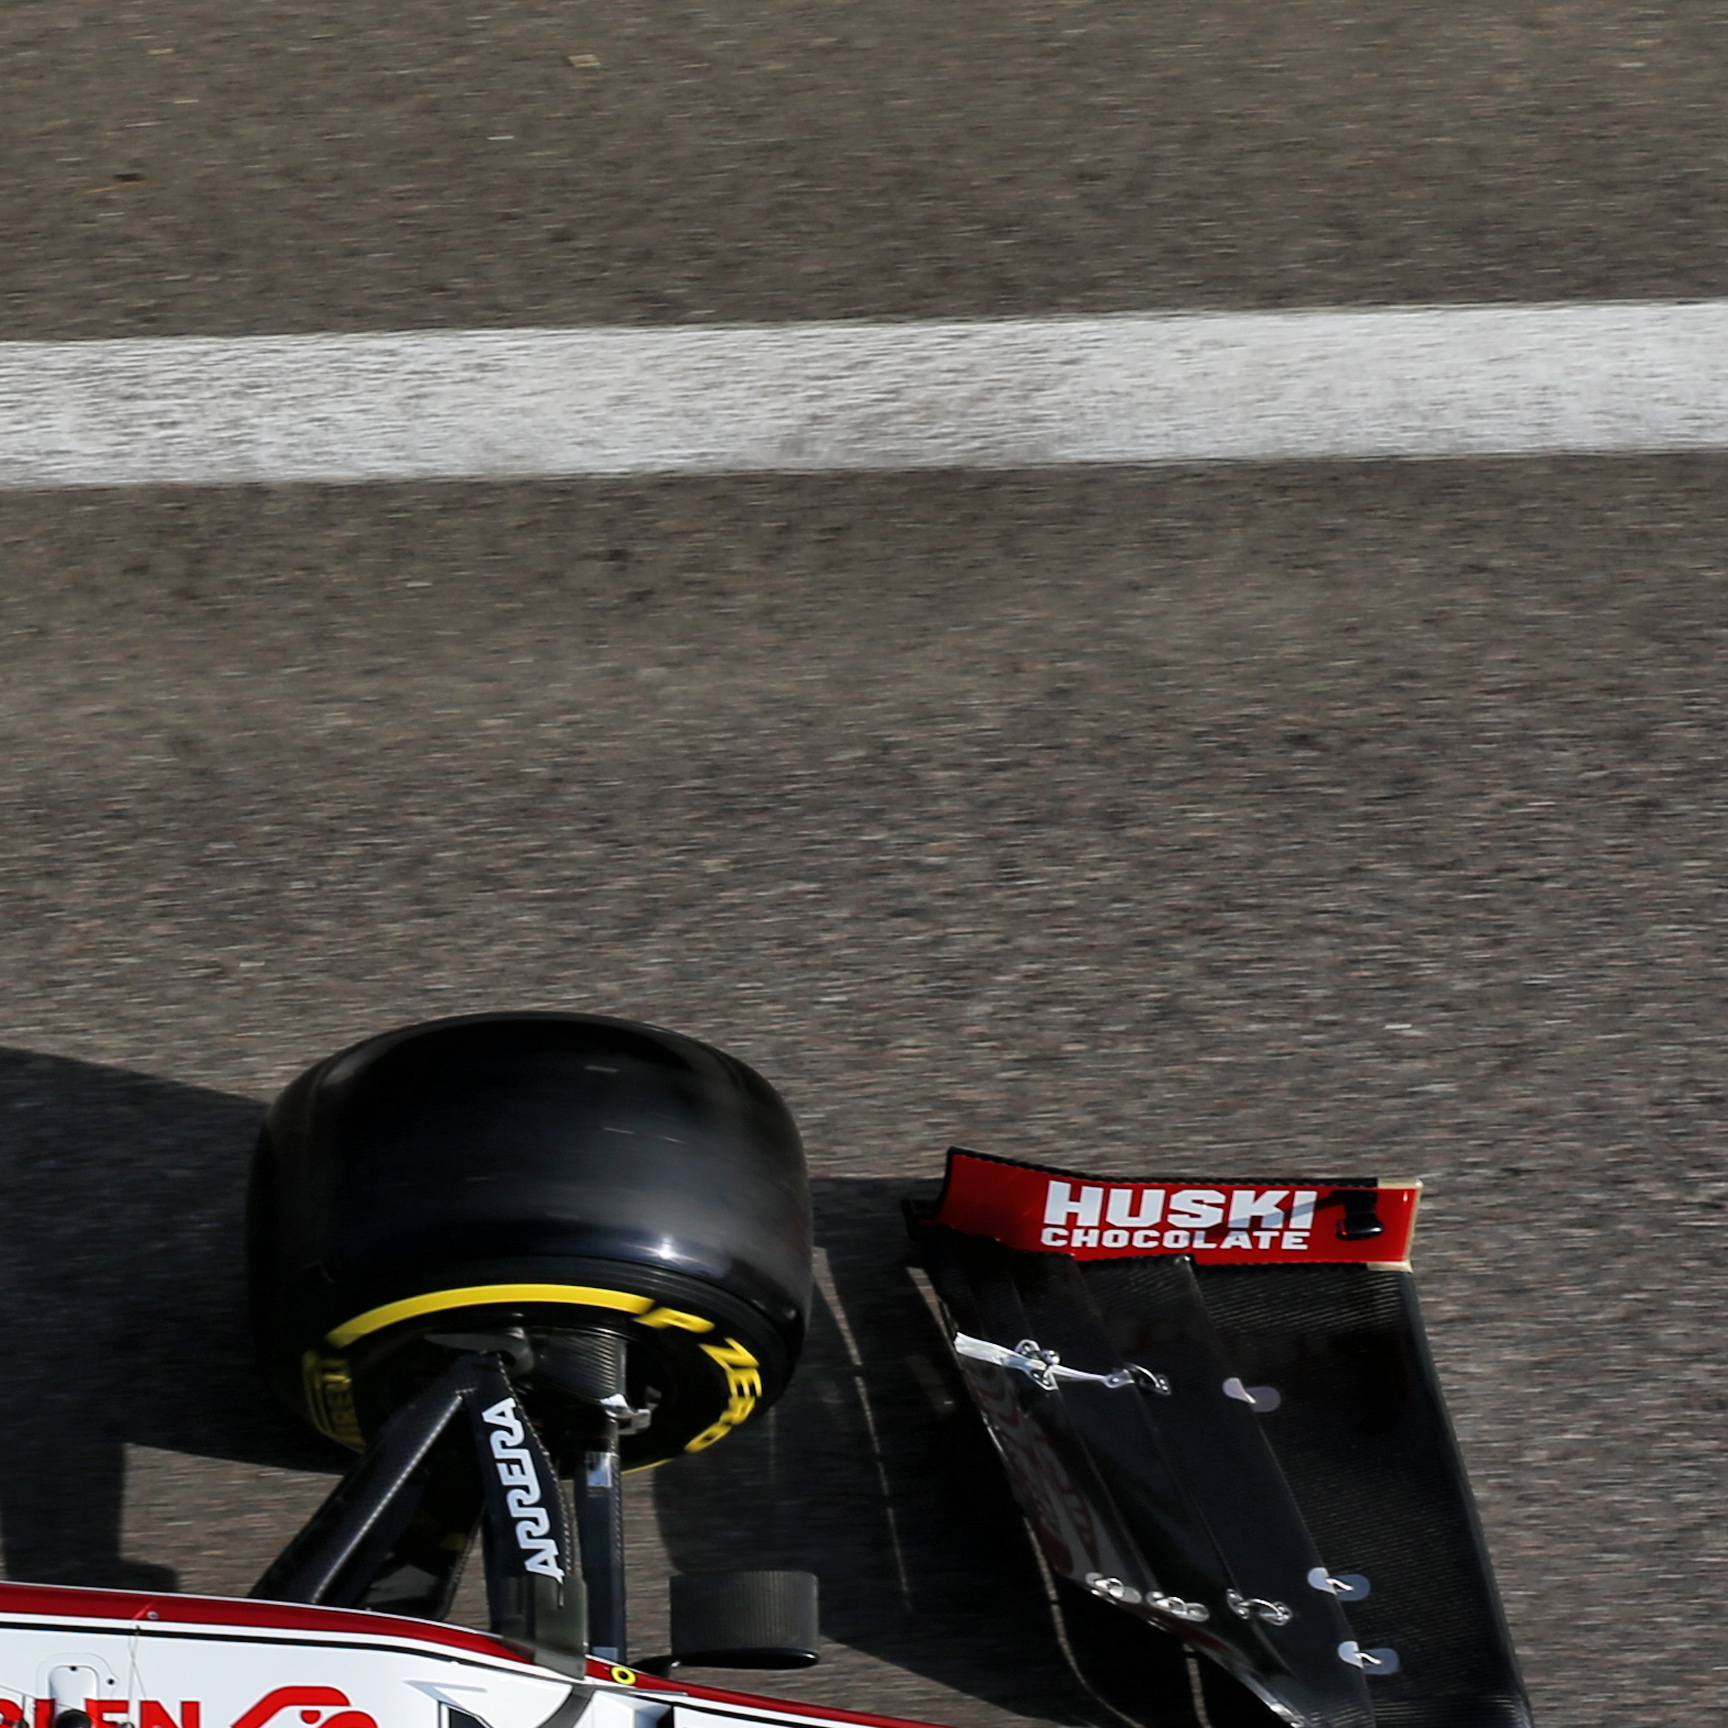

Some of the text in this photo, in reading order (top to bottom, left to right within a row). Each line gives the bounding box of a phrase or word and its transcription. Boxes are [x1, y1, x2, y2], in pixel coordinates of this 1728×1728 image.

[1043, 1180, 1317, 1229] HUSKI
[1042, 1227, 1310, 1250] CHOCOLATE
[481, 1397, 565, 1585] ARRERA
